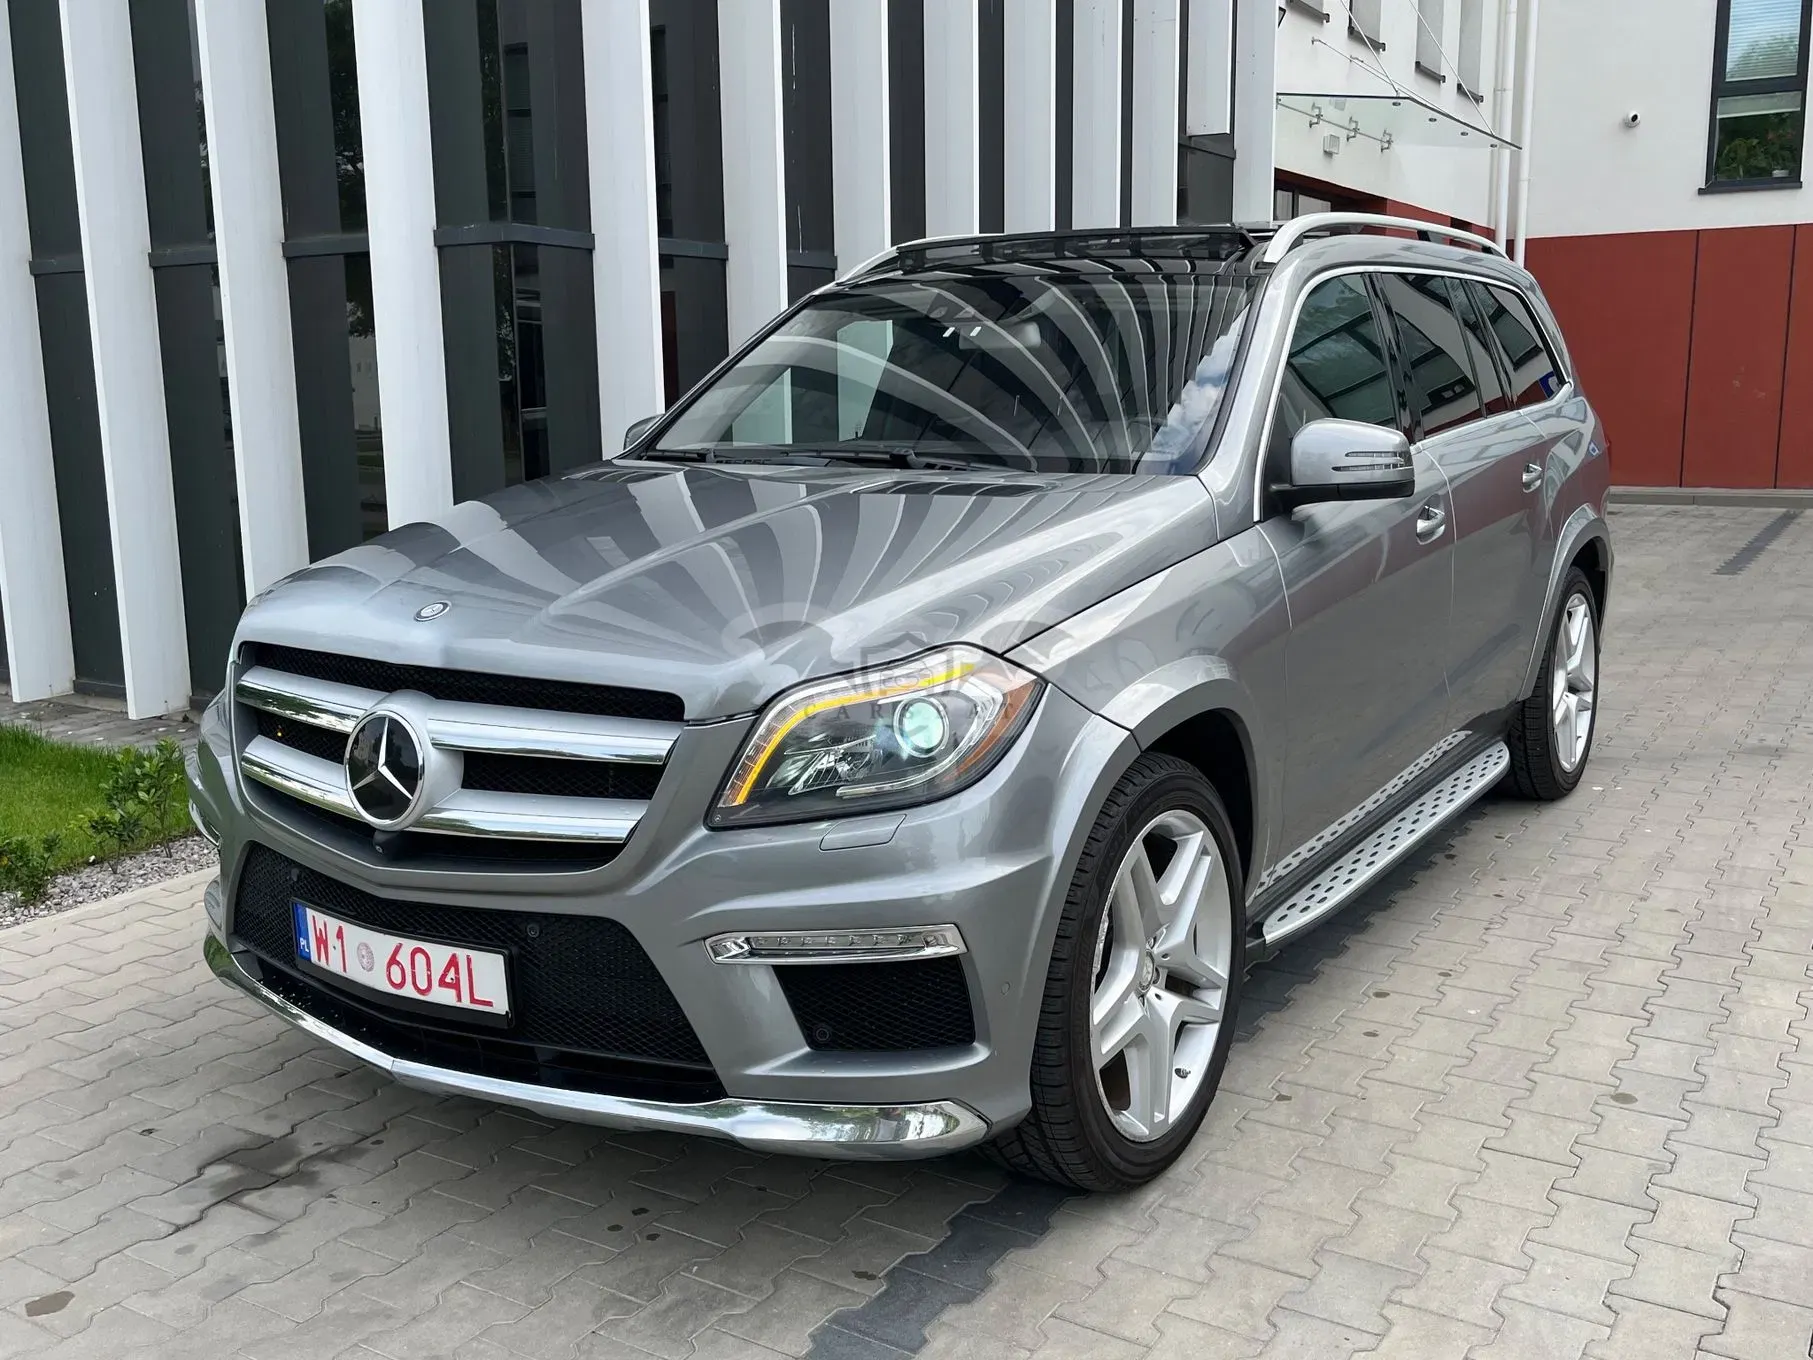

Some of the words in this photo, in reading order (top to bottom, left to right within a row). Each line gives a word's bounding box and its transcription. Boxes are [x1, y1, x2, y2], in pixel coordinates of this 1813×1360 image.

[299, 936, 310, 953] PL
[312, 915, 347, 973] W1
[386, 943, 494, 1007] 604L
